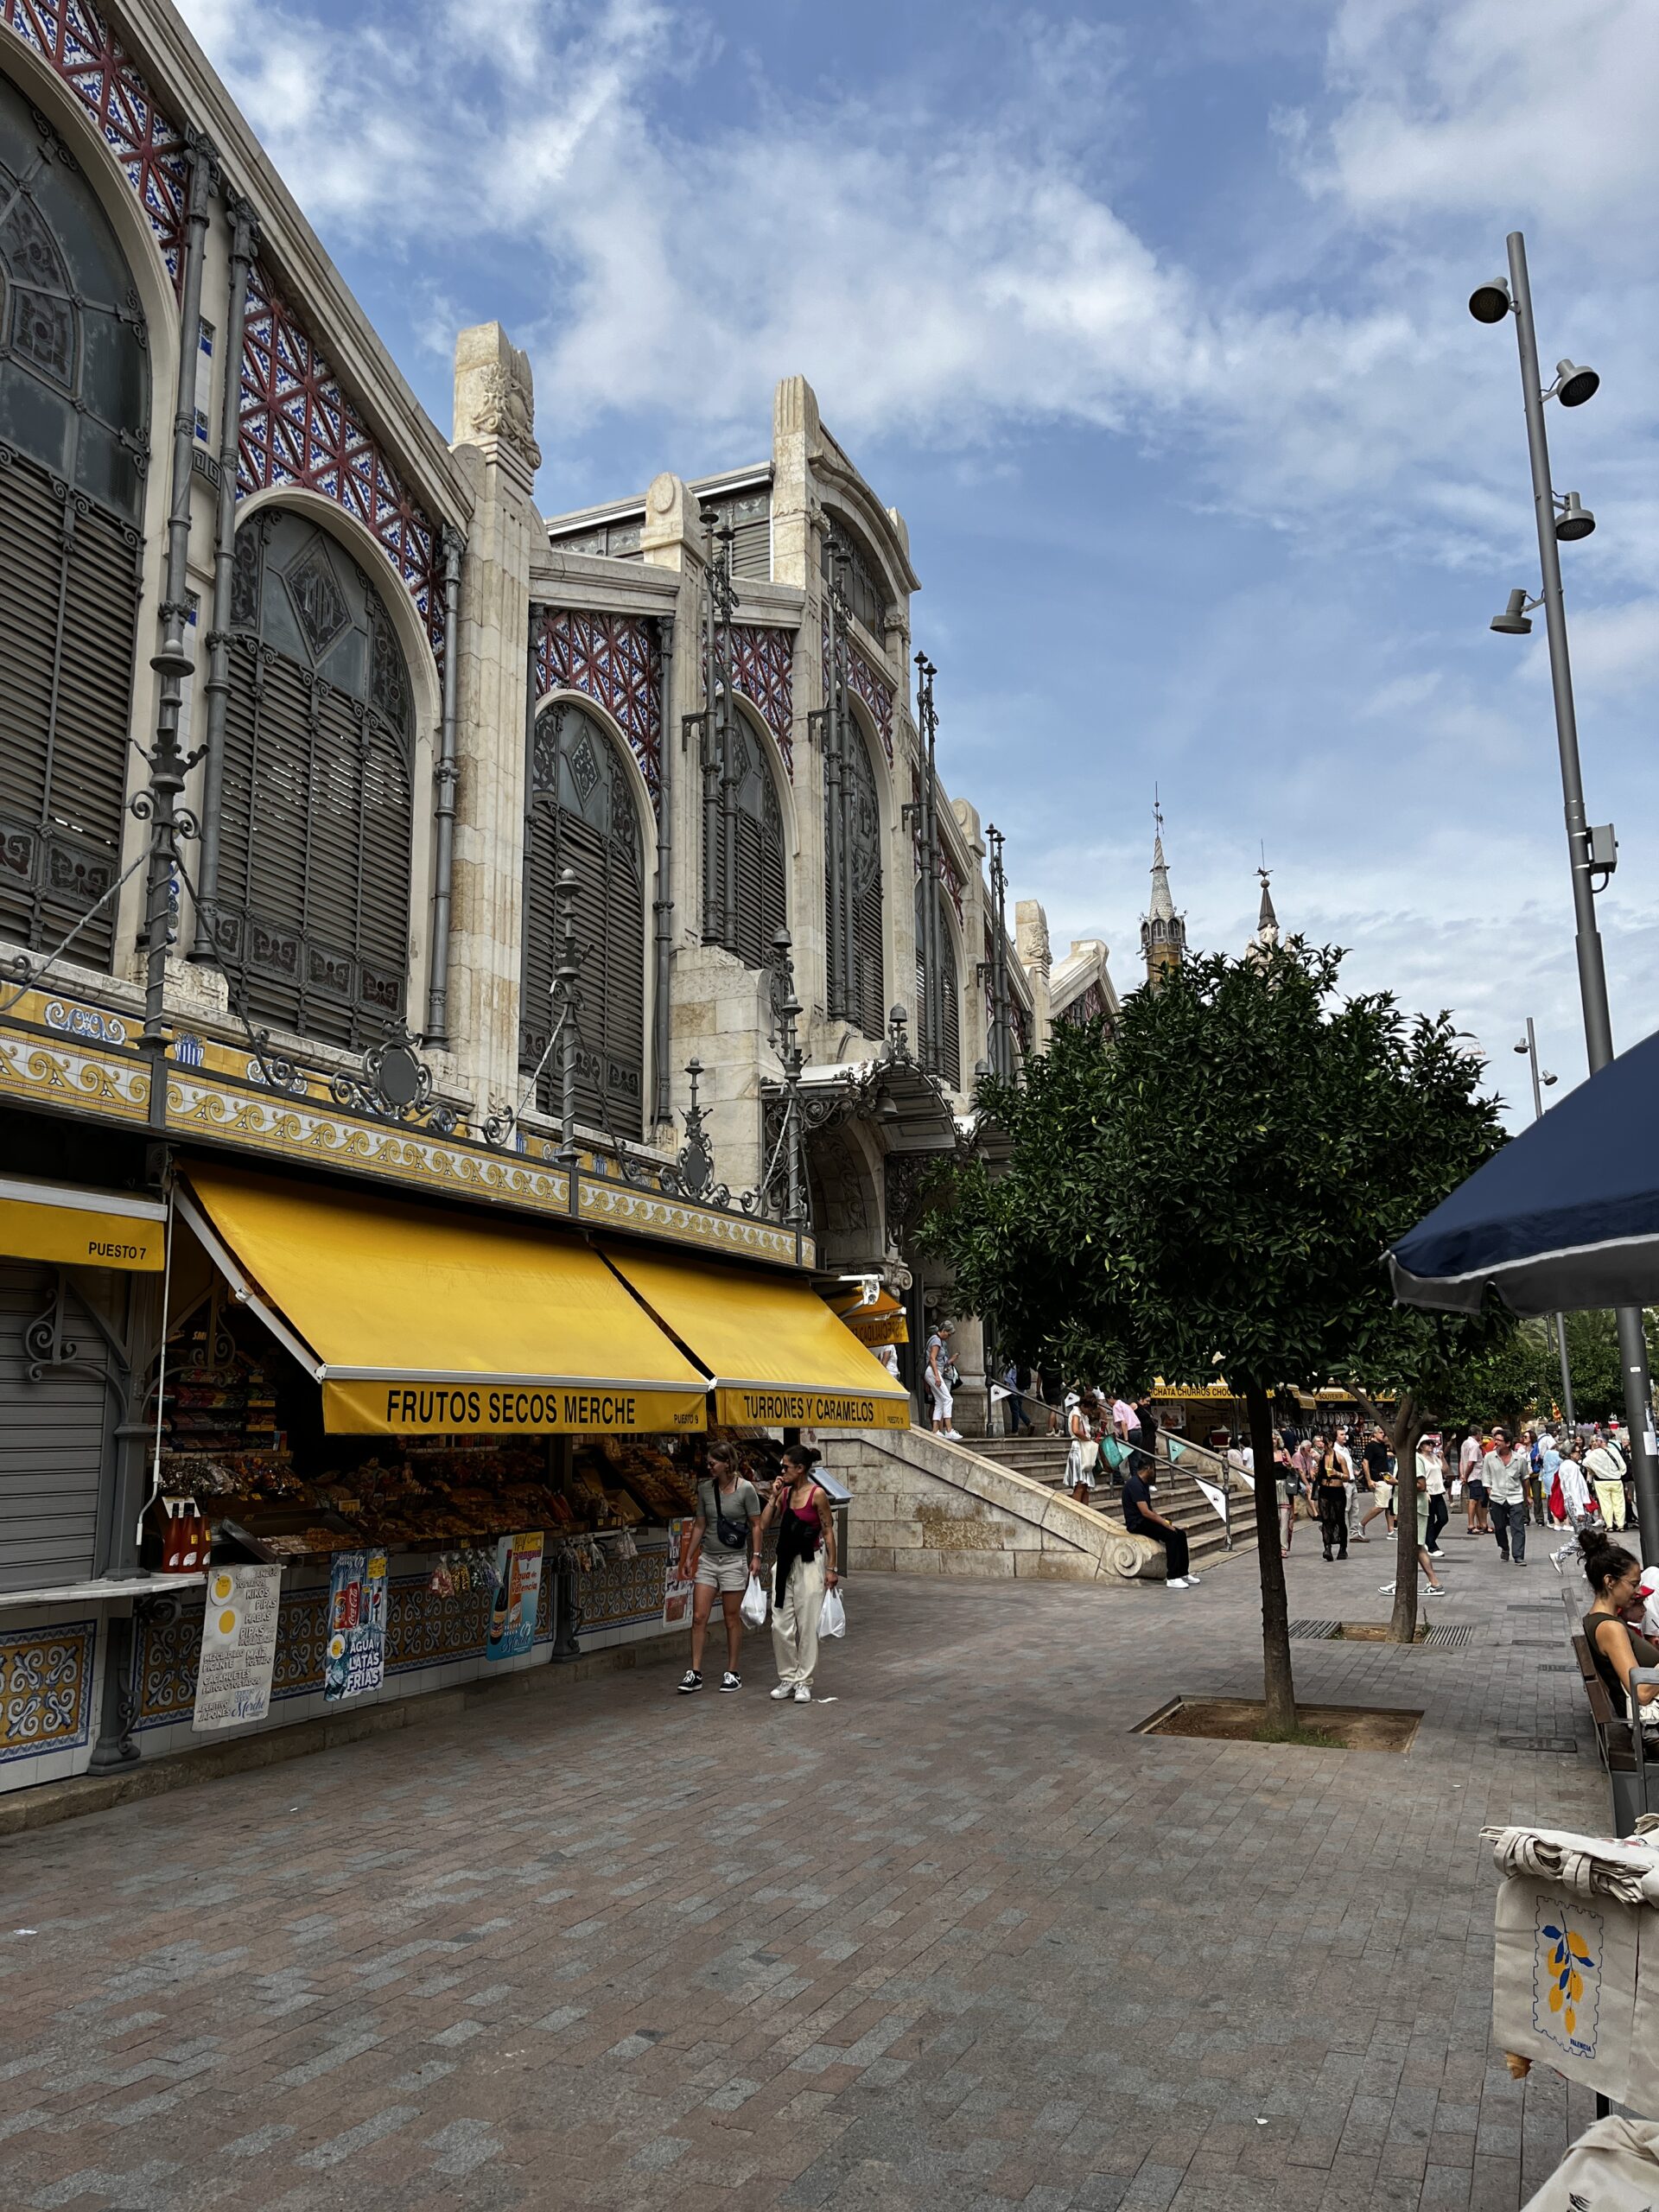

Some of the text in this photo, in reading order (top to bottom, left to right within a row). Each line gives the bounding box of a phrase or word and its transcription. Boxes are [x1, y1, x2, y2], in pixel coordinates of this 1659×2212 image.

[88, 1241, 147, 1260] PUESTO 7
[1177, 1388, 1210, 1396] CHURROS
[387, 1389, 635, 1425] FRUTOS SECOS MERCHE
[744, 1395, 874, 1422] TURRONES Y CARAMELOS
[673, 1414, 699, 1424] PUESTO 9
[512, 1572, 531, 1582] Agua
[245, 1588, 270, 1600] KIKOS
[511, 1582, 537, 1595] Valencia
[255, 1598, 277, 1611] PIPAS
[244, 1611, 272, 1624] HABAS
[238, 1625, 265, 1640] PIPAS
[349, 1638, 374, 1654] AGUA
[201, 1660, 235, 1674] PICANTE
[246, 1656, 272, 1668] TOSTADO
[349, 1652, 380, 1671] LATAS
[202, 1669, 251, 1686] CACAHUETES
[346, 1669, 379, 1691] FRÍAS
[202, 1683, 225, 1694] FRITOS
[230, 1677, 261, 1689] TOSTADOS
[1569, 2037, 1592, 2052] VALENCIA
